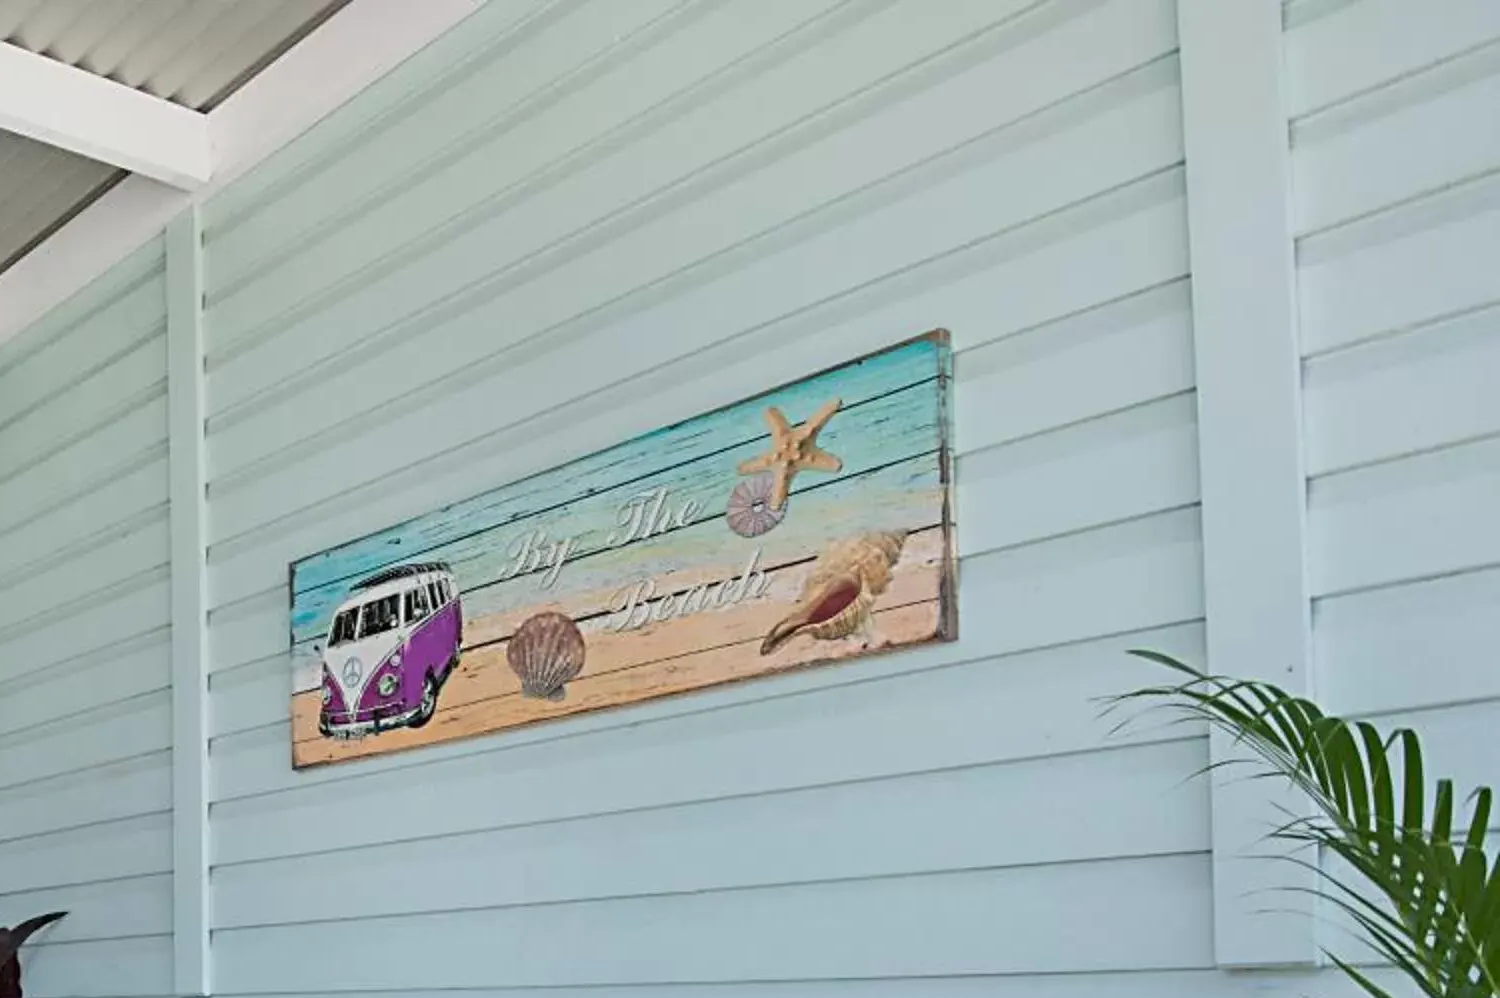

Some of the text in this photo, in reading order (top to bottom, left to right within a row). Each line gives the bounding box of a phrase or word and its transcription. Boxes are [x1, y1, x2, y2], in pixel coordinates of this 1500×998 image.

[498, 486, 707, 590] By The
[600, 545, 772, 632] Beach
